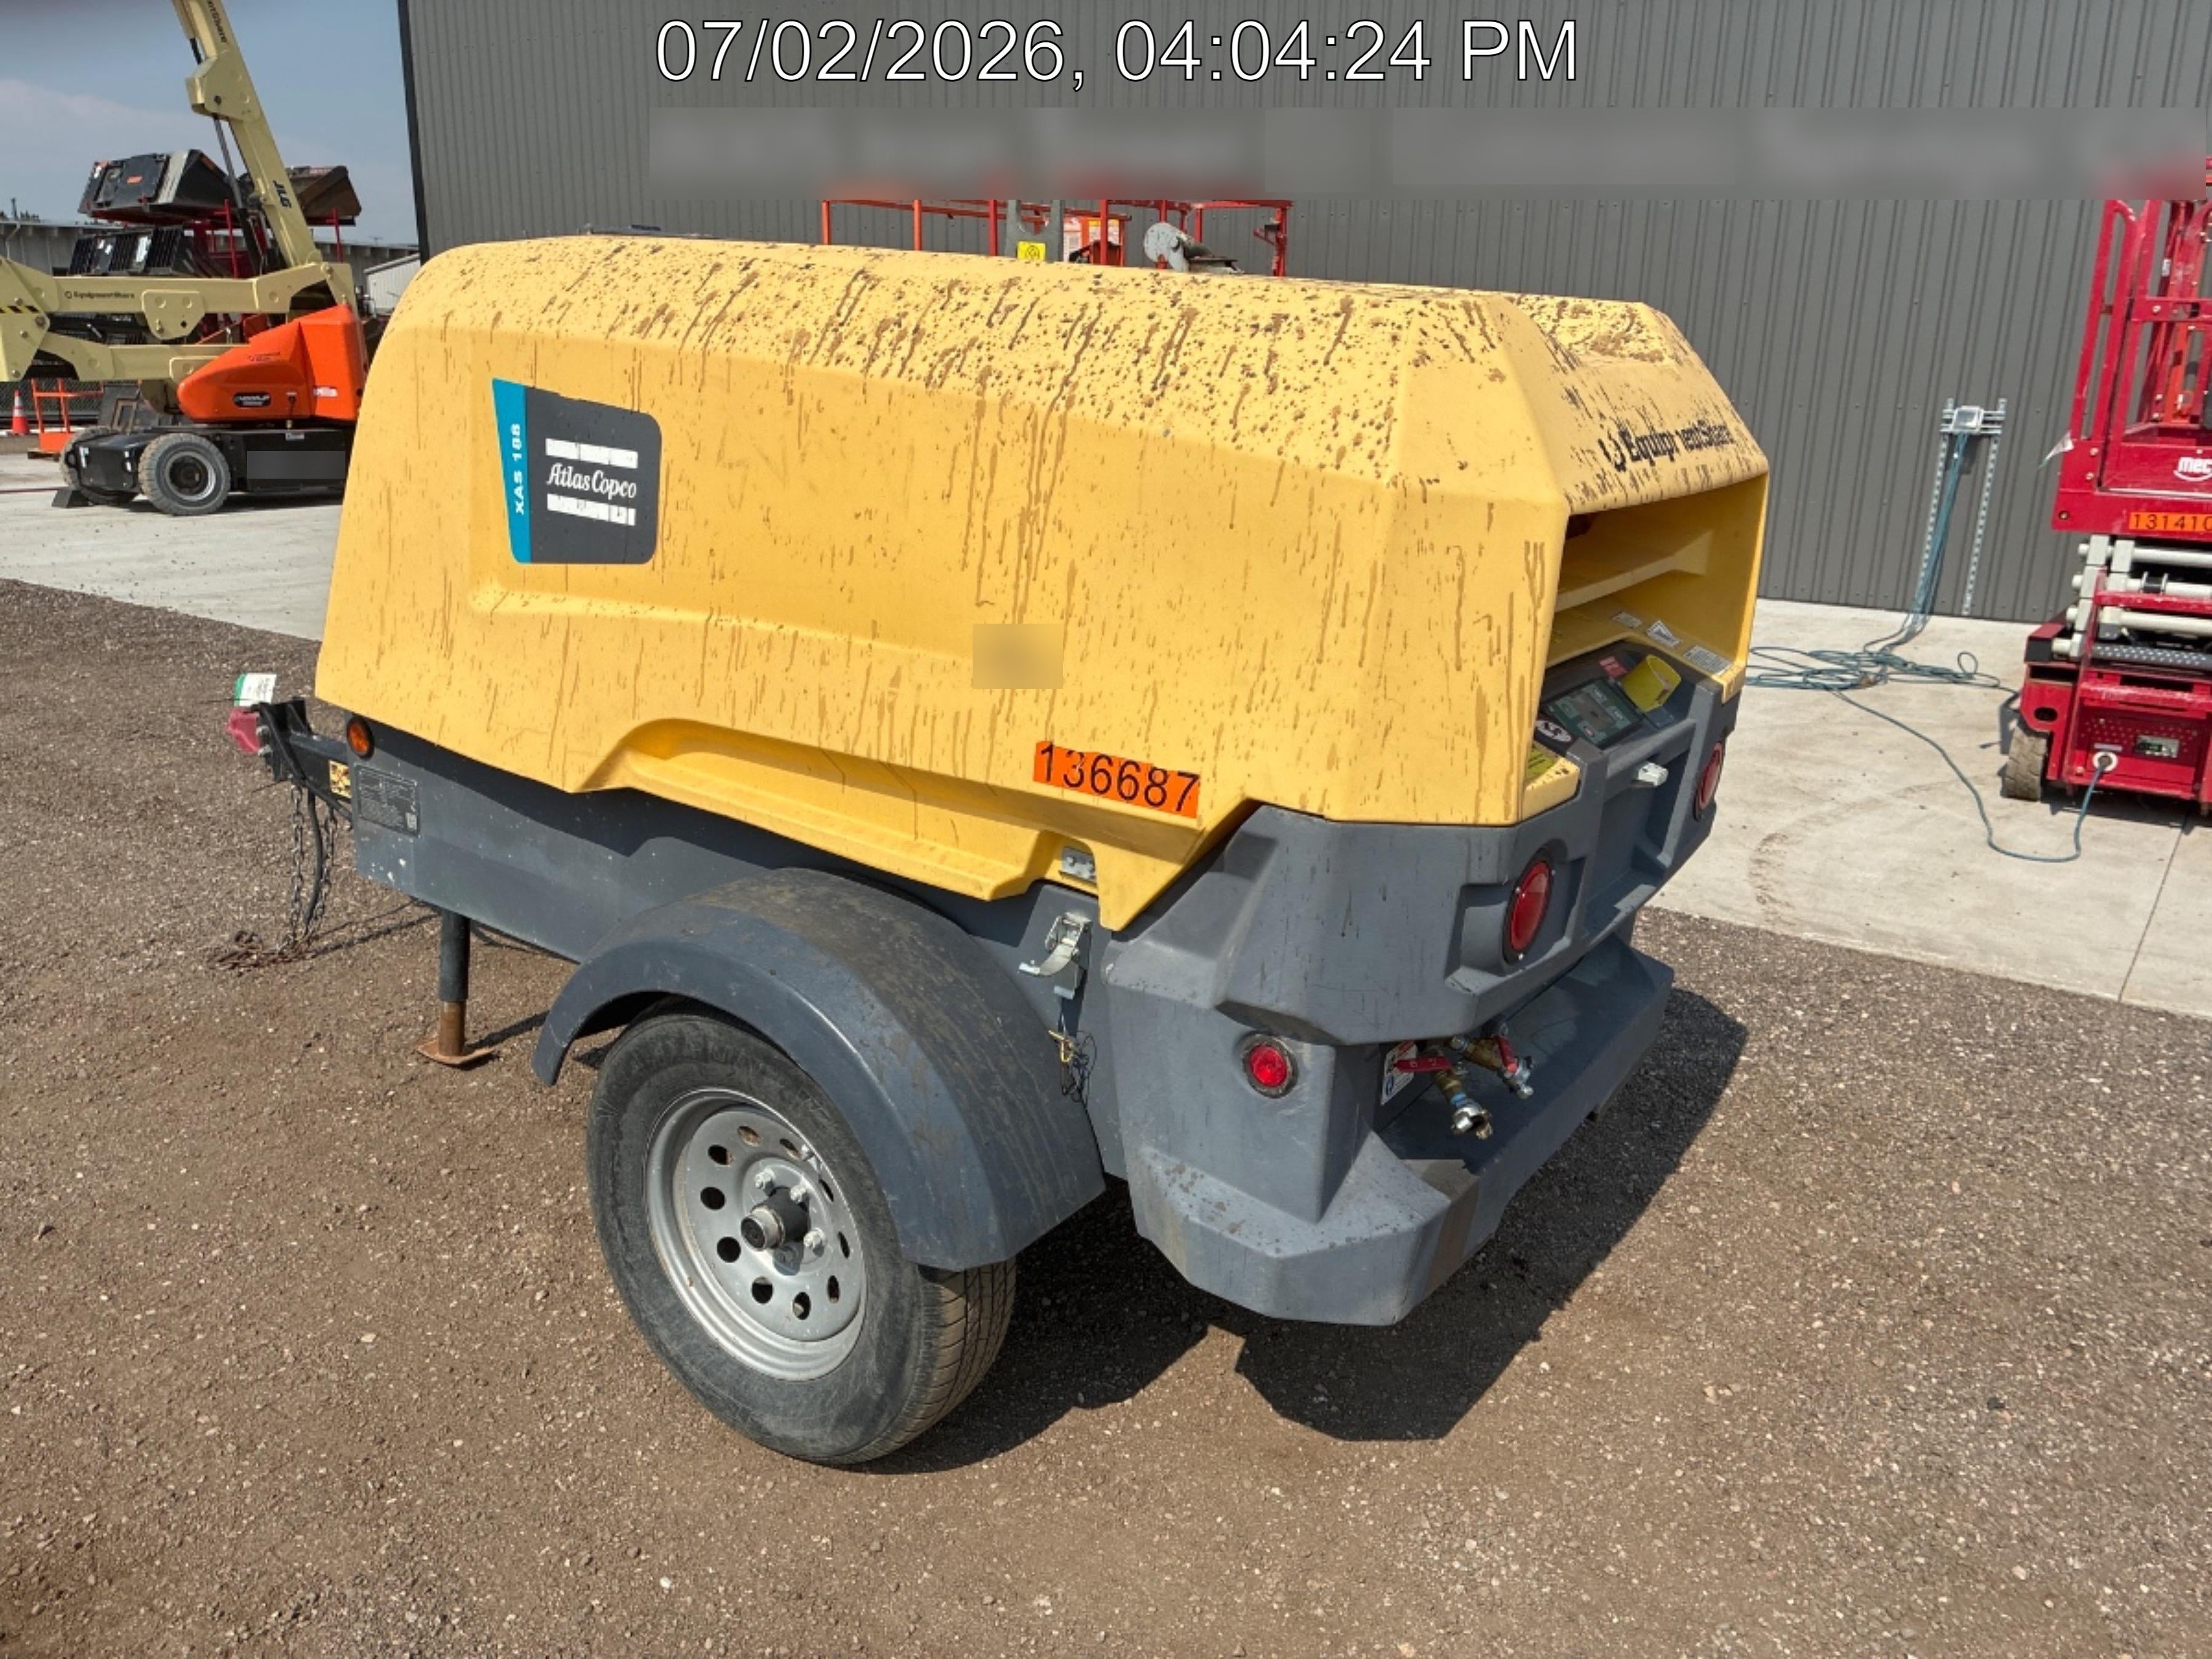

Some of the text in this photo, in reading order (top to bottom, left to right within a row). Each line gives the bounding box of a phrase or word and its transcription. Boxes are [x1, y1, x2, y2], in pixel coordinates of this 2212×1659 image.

[514, 469, 525, 515] XAS
[546, 461, 637, 501] Atlas Copco
[1041, 742, 1200, 812] 136687
